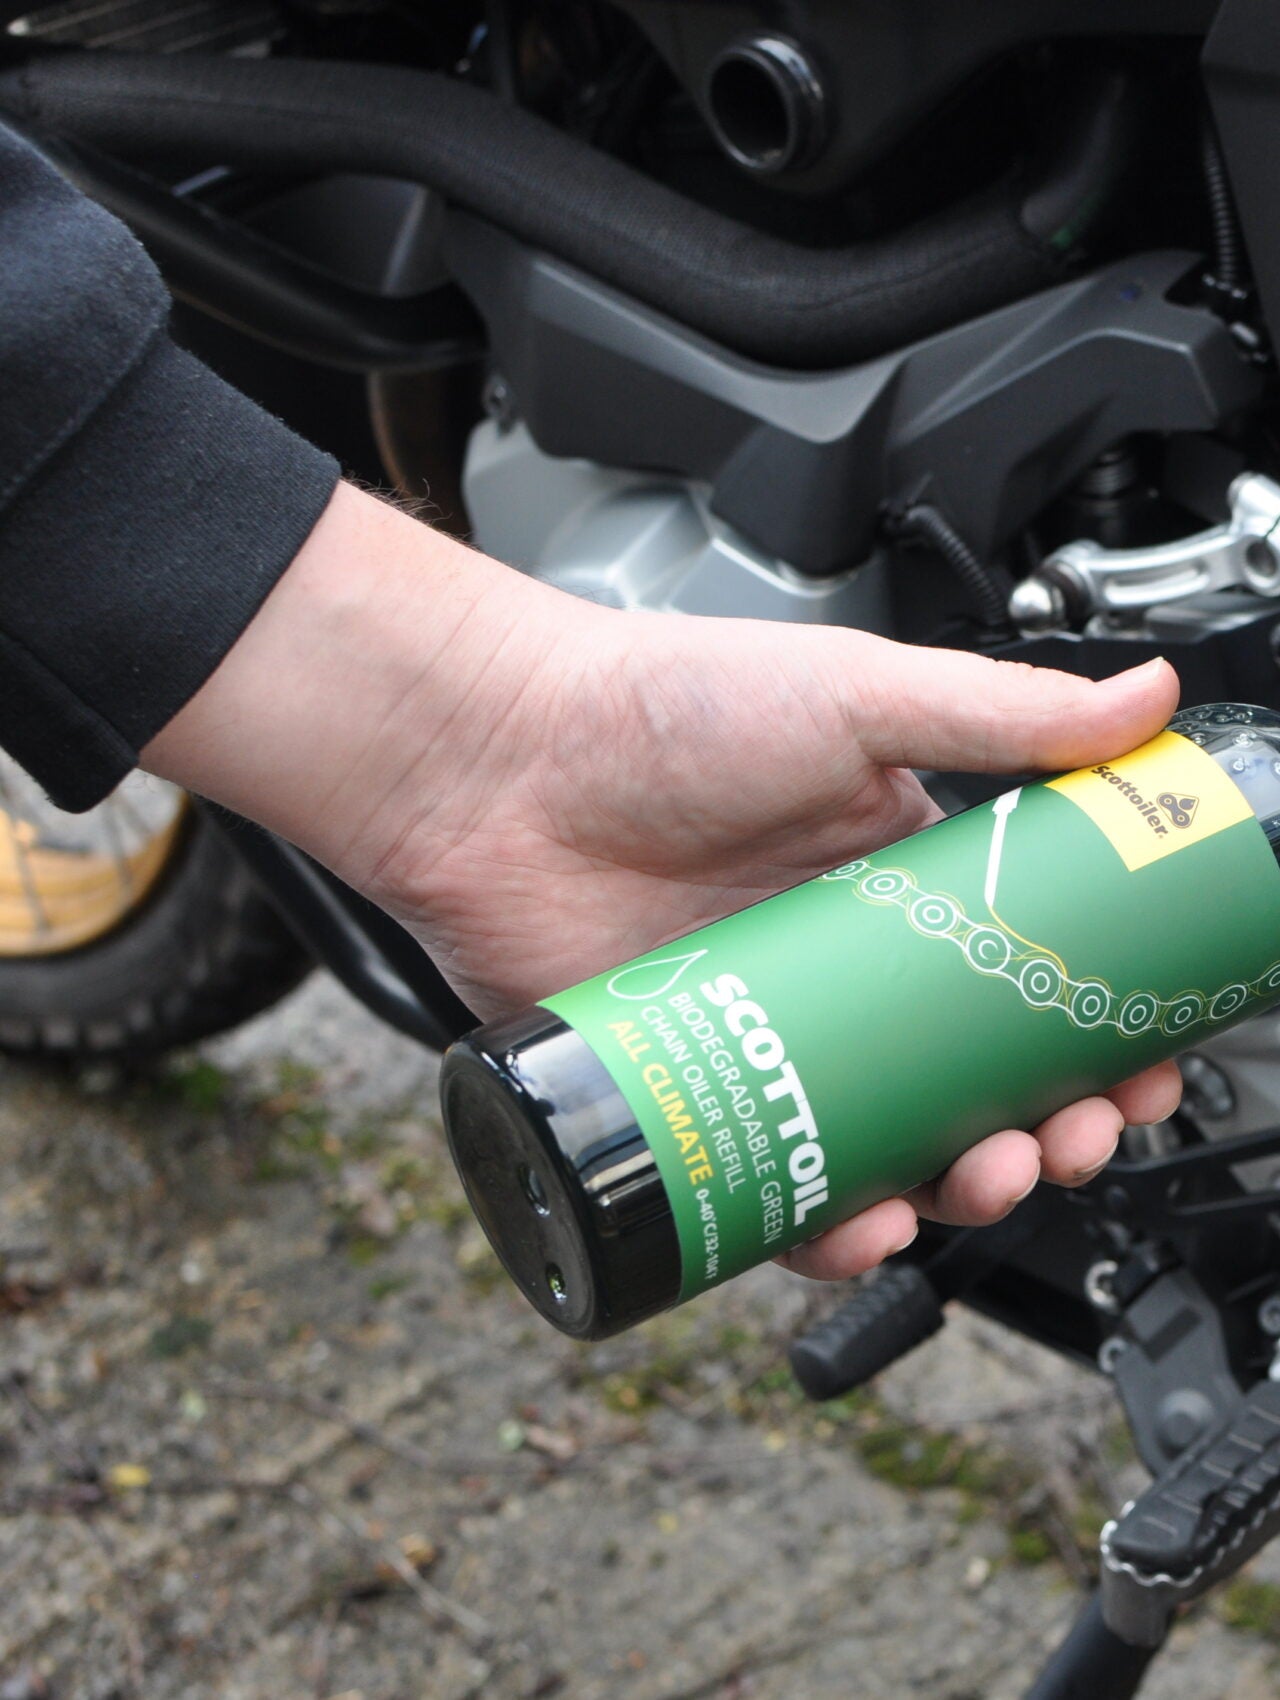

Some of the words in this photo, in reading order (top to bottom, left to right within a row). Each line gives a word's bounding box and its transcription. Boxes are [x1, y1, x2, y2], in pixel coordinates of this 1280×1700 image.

[608, 1020, 650, 1063] ALL
[642, 1063, 714, 1185] CLIMATE
[641, 1005, 692, 1063] CHAIN
[682, 1065, 723, 1126] OILER
[711, 1127, 747, 1194] REFILL
[668, 992, 777, 1178] BIODEGRADABLE
[760, 1181, 784, 1244] GREEN
[700, 973, 828, 1226] SCOTTOIL
